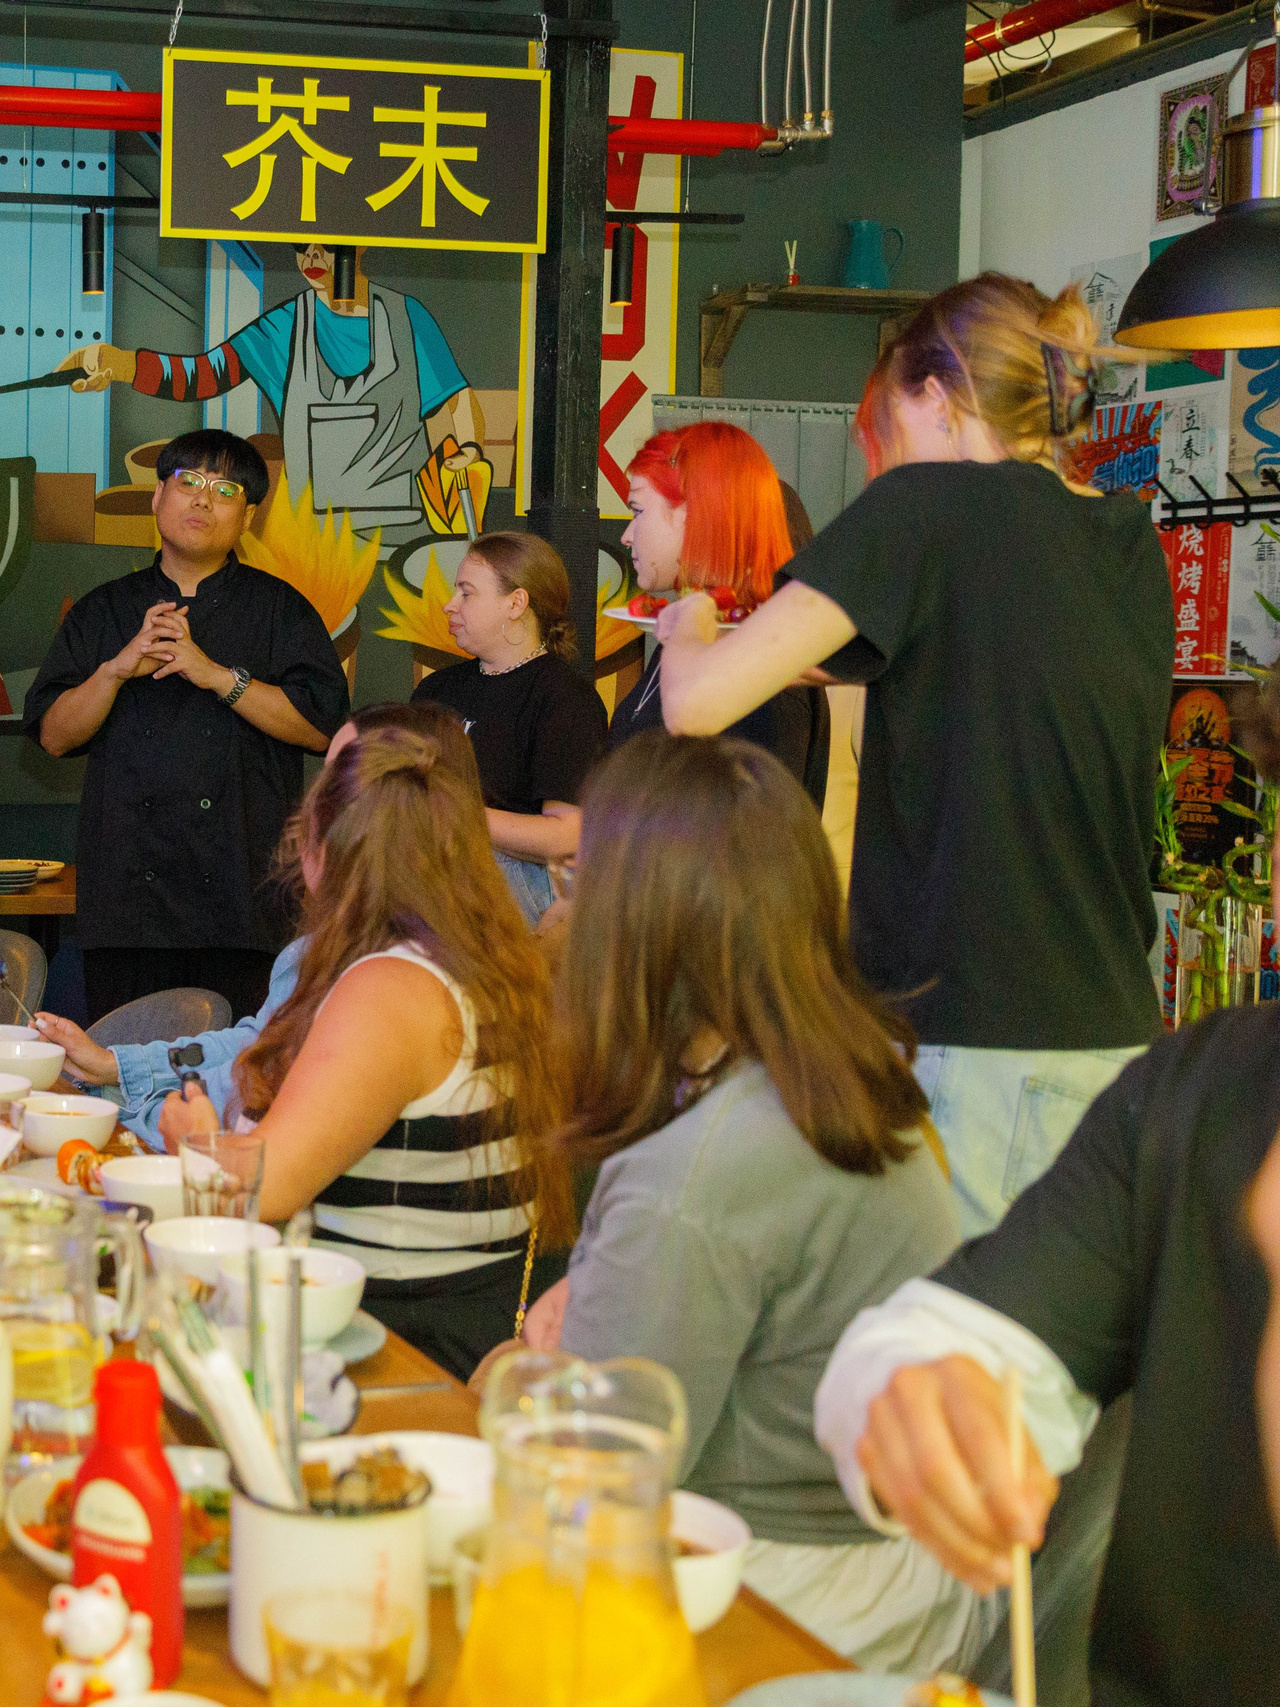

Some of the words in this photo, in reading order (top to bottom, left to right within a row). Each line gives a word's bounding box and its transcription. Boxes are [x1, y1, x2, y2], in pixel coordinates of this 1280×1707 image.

[222, 76, 490, 228] 芥末
[1174, 523, 1205, 671] 烧烤盛宴
